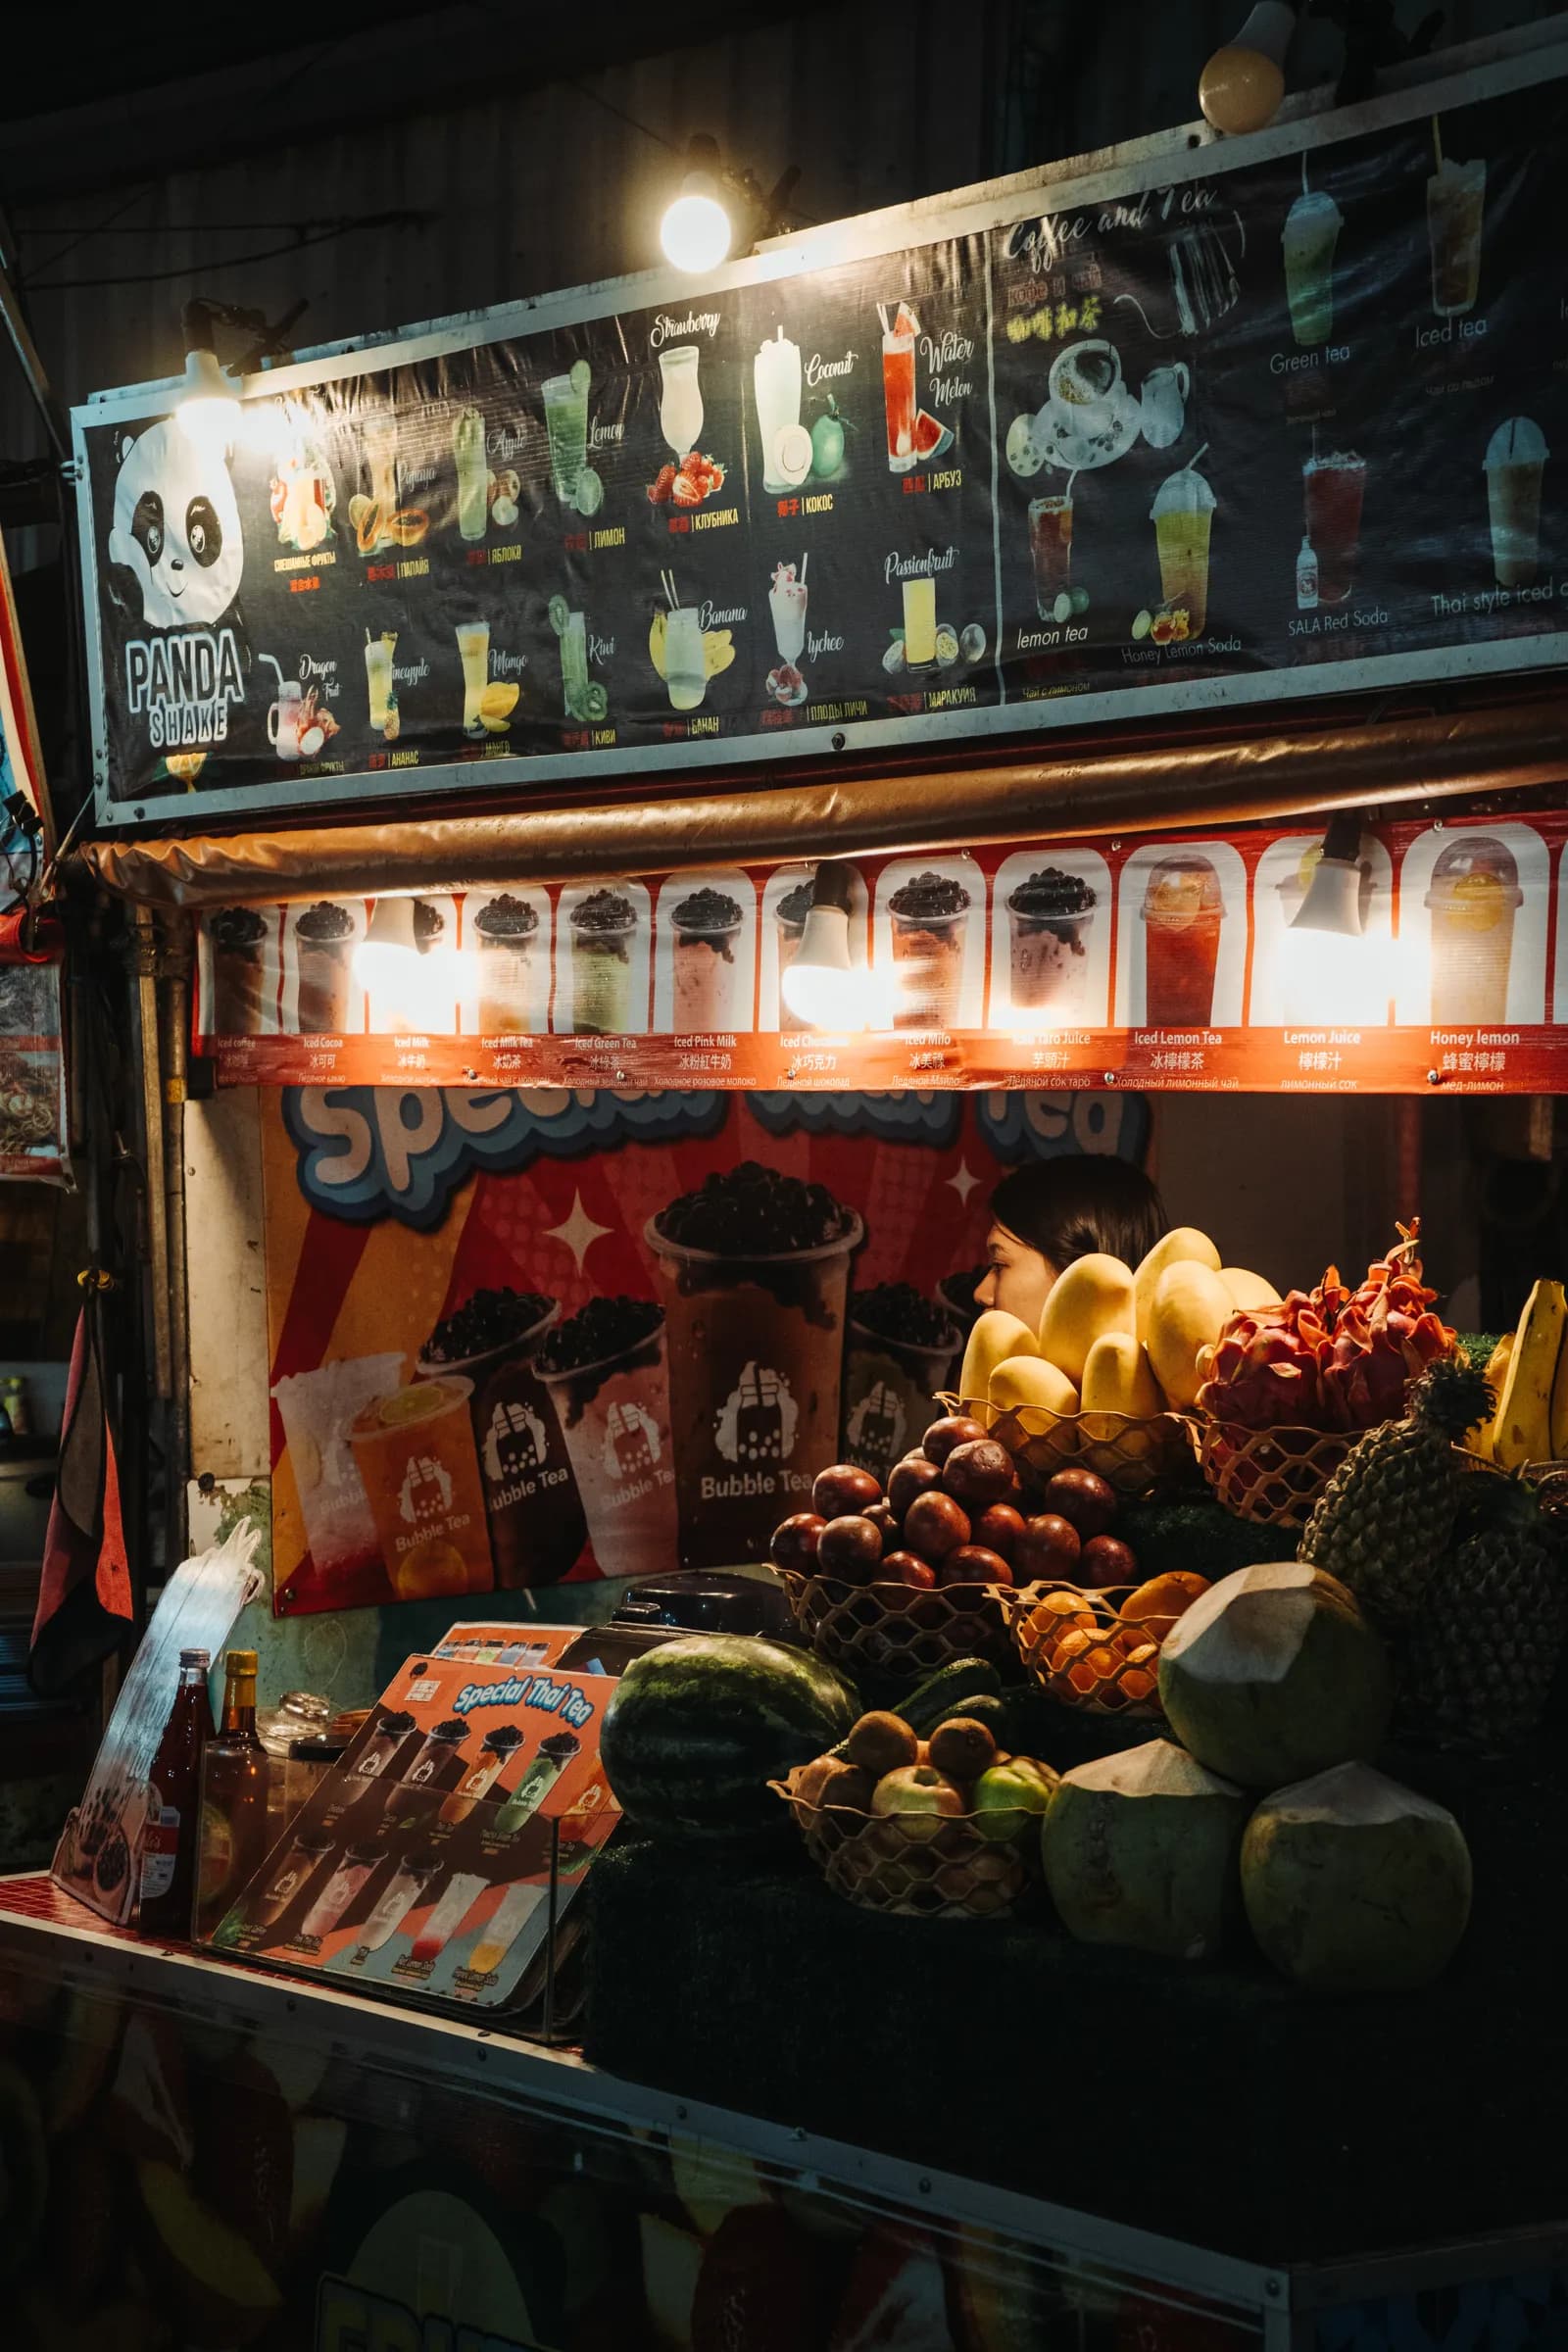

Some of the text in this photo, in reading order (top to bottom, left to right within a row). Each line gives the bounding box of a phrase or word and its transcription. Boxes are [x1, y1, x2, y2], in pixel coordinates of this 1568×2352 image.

[1003, 215, 1091, 274] Coffee
[1098, 190, 1151, 233] and
[650, 311, 720, 347] Strawberry
[1415, 318, 1488, 348] Iced tea
[919, 330, 974, 374] Water
[1270, 345, 1350, 375] Green tea
[804, 351, 858, 386] Coconut
[929, 376, 973, 408] Melon
[588, 416, 624, 448] Lemon
[487, 428, 525, 461] Apple
[933, 469, 962, 490] АРБУЗ
[807, 494, 833, 513] КОКОС
[695, 509, 739, 530] КЛУБНИКА
[594, 527, 625, 550] ЛИМОН
[884, 546, 959, 585] Passionfruit
[1431, 593, 1466, 616] Thai
[1473, 589, 1511, 614] style
[1516, 576, 1553, 606] iced
[699, 600, 748, 632] Banana
[1288, 607, 1389, 636] SALA Red Soda
[1017, 626, 1089, 649] lemon tea
[589, 634, 615, 665] Kiwi
[1121, 635, 1242, 665] Honey Lemon Soda
[125, 628, 245, 714] PANDA
[299, 654, 337, 680] Dragon
[392, 657, 431, 686] ineapple
[491, 649, 527, 676] Mango
[810, 702, 844, 721] ПЛОДЫ
[844, 700, 868, 717] ЛИЧИ
[149, 703, 228, 748] SHAKE
[691, 716, 719, 735] БАНАН
[595, 728, 616, 745] КИВИ
[392, 750, 419, 766] АНАНАС
[304, 1037, 343, 1048] Iced Cocoa
[394, 1037, 430, 1048] Iced Milk
[481, 1036, 533, 1048] Iced Milk Tea
[575, 1036, 637, 1049] Iced Green Tea
[674, 1035, 737, 1048] Iced Pink Milk
[780, 1035, 800, 1048] Iced
[929, 1033, 951, 1045] Milo
[1062, 1032, 1091, 1044] Juice
[1134, 1031, 1222, 1045] Iced Lemon Tea
[1284, 1031, 1360, 1044] Lemon Juice
[1431, 1030, 1520, 1048] Honey lemon
[310, 1054, 337, 1067] 冰可可
[492, 1054, 521, 1069] 冰奶茶
[679, 1054, 732, 1070] 冰粉紅牛奶
[792, 1054, 837, 1070] 冰巧克力
[1033, 1052, 1070, 1069] 芋頭汁
[1150, 1052, 1204, 1070] 冰檸檬茶
[1298, 1052, 1343, 1071] 檸檬汁
[1443, 1052, 1506, 1071] 蜂蜜檸檬
[726, 1076, 757, 1086] молоко
[1051, 1076, 1066, 1086] сок
[1114, 1075, 1239, 1090] Холодный лимонный чай
[1280, 1076, 1357, 1090] лимонный сок
[1441, 1080, 1504, 1091] мед-лимон
[490, 1465, 569, 1512] ubble Tea
[701, 1470, 813, 1499] Bubble Tea
[395, 1512, 470, 1552] Bubble Tea
[454, 1675, 533, 1715] Special
[526, 1677, 570, 1713] Thai
[560, 1688, 595, 1729] Tea
